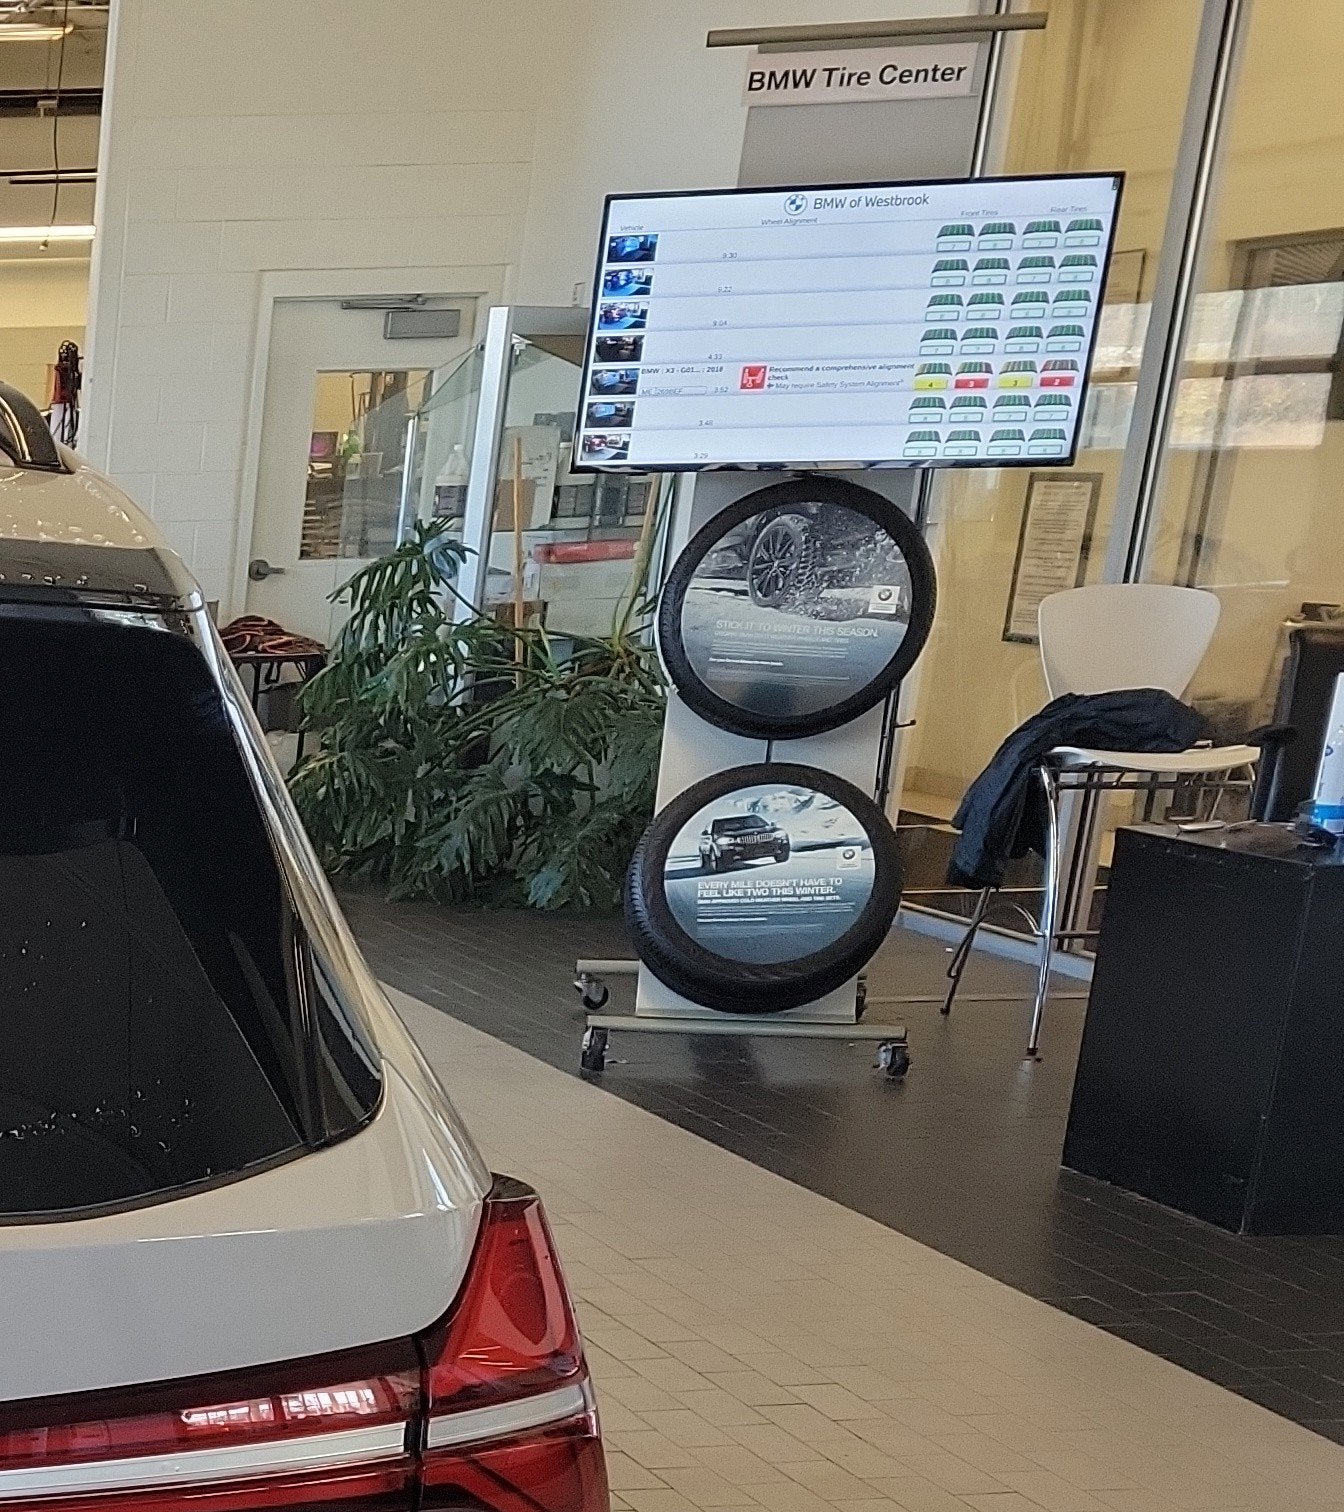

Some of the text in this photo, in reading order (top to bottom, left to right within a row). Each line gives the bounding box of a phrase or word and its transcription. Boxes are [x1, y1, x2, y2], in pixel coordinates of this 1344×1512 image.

[747, 63, 967, 92] BMW Tire Center
[813, 194, 930, 210] BMW of Westbrook
[783, 217, 818, 227] Alignment
[769, 365, 814, 373] Recommend
[821, 364, 877, 373] comprehensive
[877, 363, 915, 372] alignment
[767, 373, 789, 381] check
[775, 382, 791, 390] May
[839, 380, 865, 389] System
[774, 623, 811, 635] WINTER
[812, 625, 835, 637] THIS
[697, 877, 843, 890] EVERY MILE DOESN'T HAVE TO
[697, 886, 837, 898] FEEL LIKE TWO THIS WINTER.
